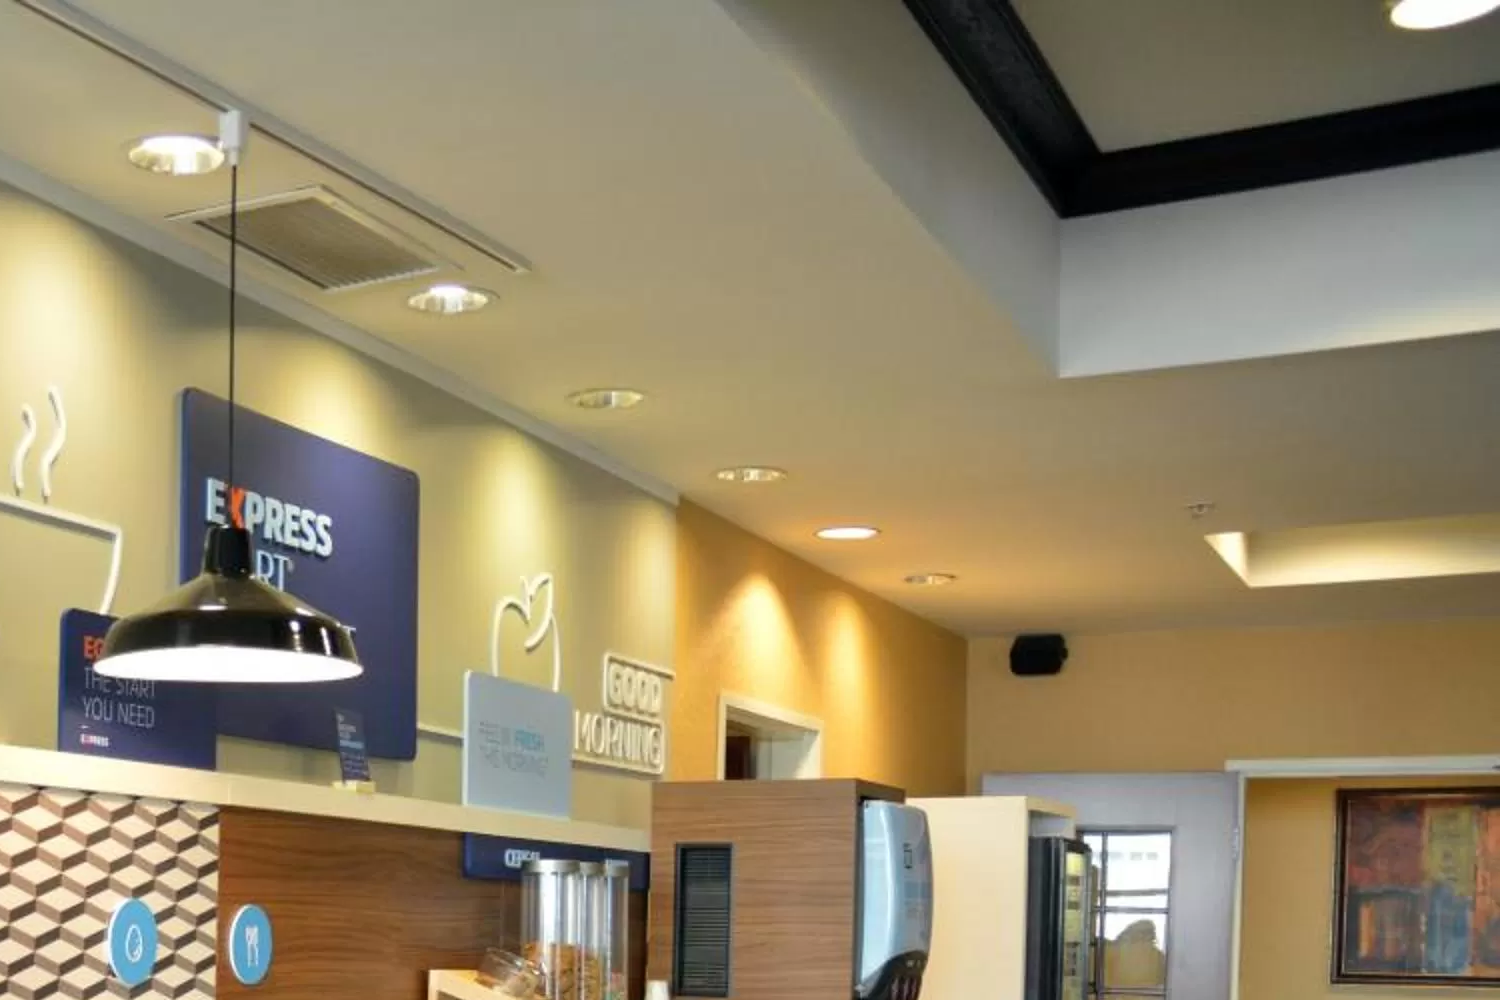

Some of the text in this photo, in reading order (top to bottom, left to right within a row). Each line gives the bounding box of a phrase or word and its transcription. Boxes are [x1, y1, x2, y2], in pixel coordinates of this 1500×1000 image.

[206, 477, 333, 557] EXPRESS
[83, 666, 156, 698] THE START
[608, 662, 661, 712] GOOD
[82, 696, 156, 729] YOU NEED
